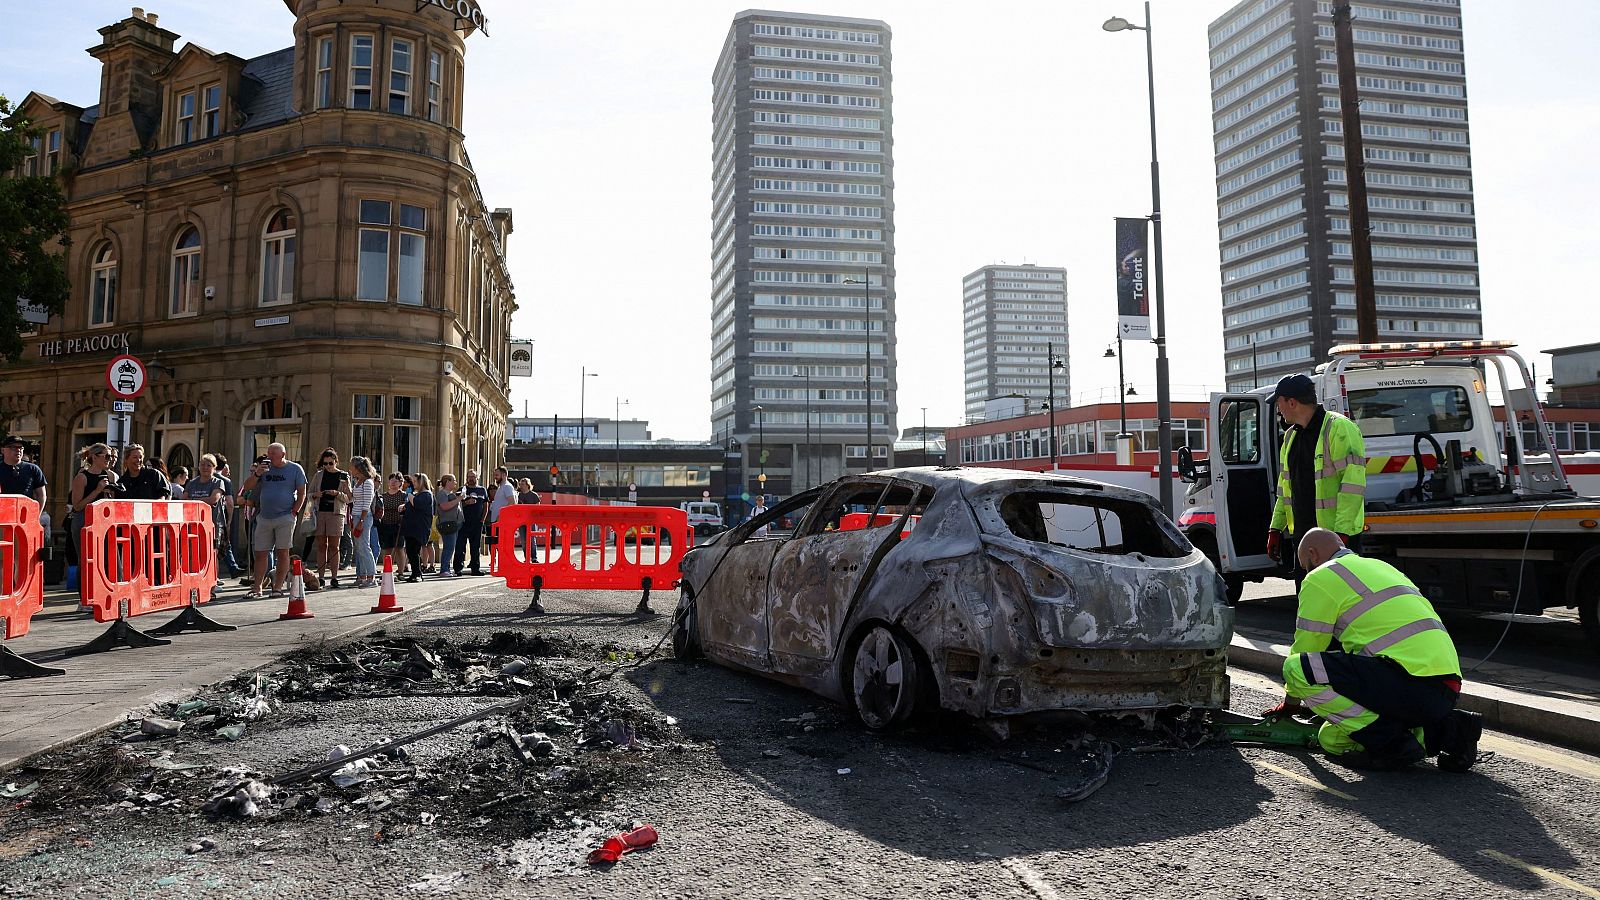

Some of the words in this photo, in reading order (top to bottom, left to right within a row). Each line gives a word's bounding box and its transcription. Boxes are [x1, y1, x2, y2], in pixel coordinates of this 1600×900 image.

[422, 0, 489, 37] COCK
[1132, 257, 1143, 300] Talent
[38, 340, 62, 356] THE
[67, 332, 130, 354] PEACOCK
